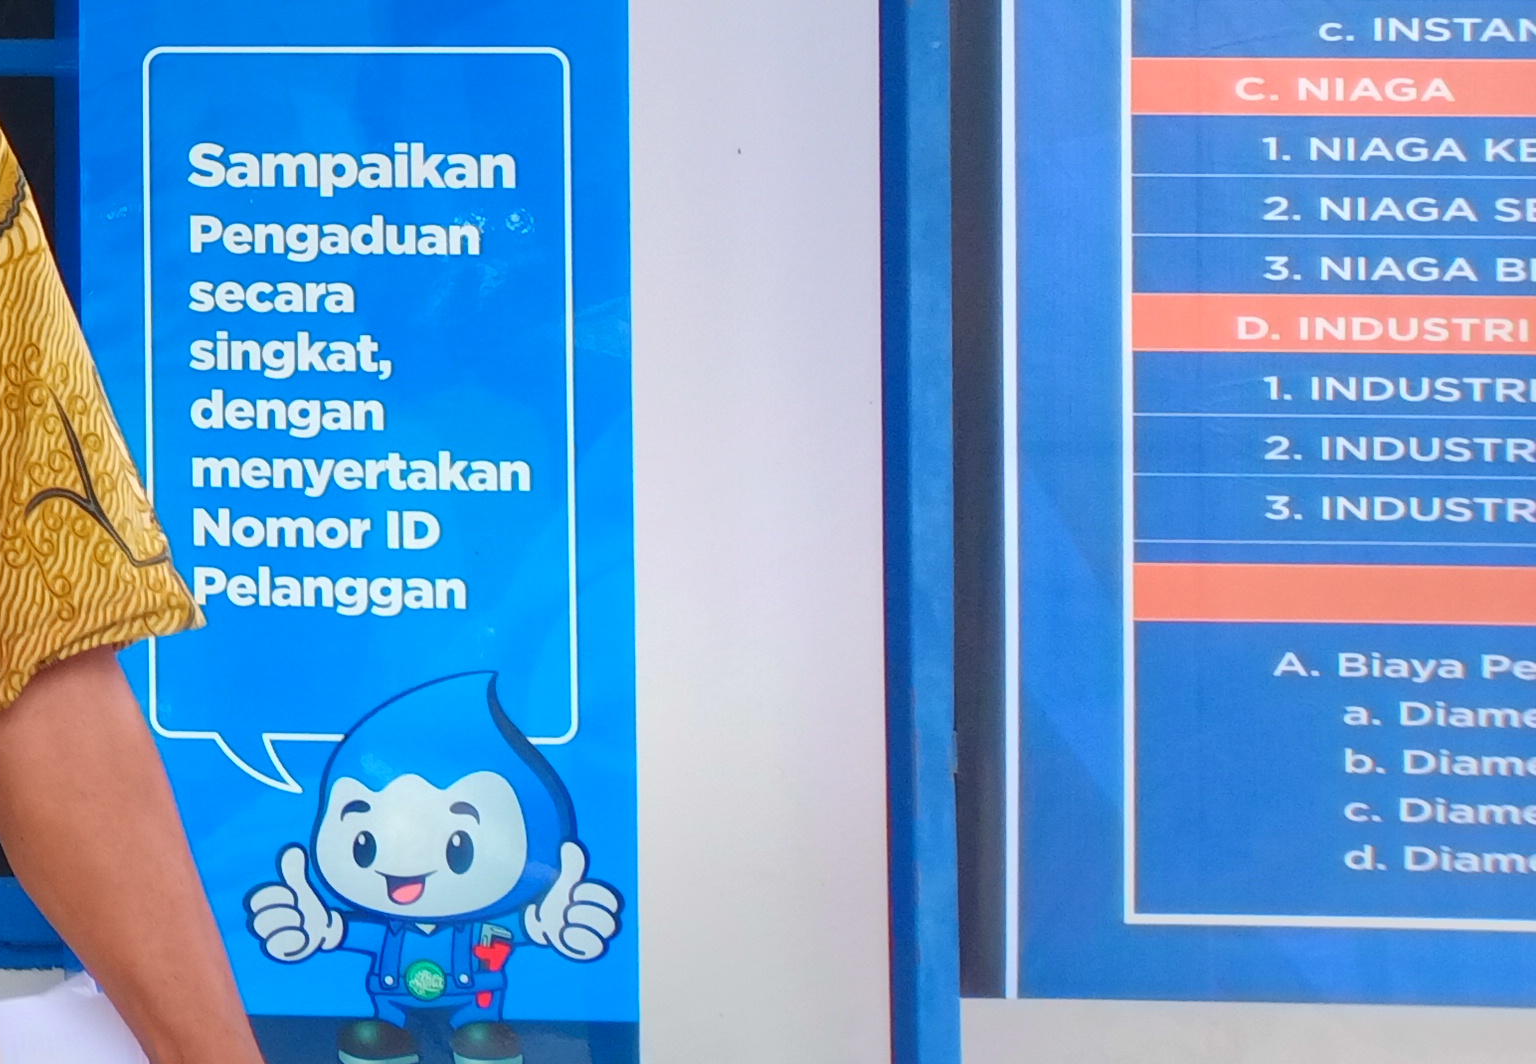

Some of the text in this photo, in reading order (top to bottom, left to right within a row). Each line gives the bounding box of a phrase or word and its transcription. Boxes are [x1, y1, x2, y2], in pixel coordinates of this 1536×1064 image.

[1235, 78, 1455, 101] C. NIAGA
[1262, 137, 1466, 162] 1. NIAGA
[188, 142, 516, 197] Sampaikan
[1263, 197, 1478, 222] 2. NIAGA
[189, 215, 482, 262] Pengaduan
[1263, 256, 1478, 282] 3. NIAGA
[188, 280, 356, 314] secara
[1236, 317, 1528, 342] D. INDUSTRI
[189, 332, 392, 380] singkat,
[1263, 376, 1292, 401] 1.
[190, 390, 384, 438] dengan
[1263, 436, 1302, 461] 2.
[192, 451, 532, 497] menyertakan
[1265, 495, 1302, 521] 3.
[192, 508, 440, 550] Nomor ID
[193, 567, 467, 616] Pelanggan
[1273, 652, 1465, 683] A. Biaya
[1343, 706, 1382, 727] a.
